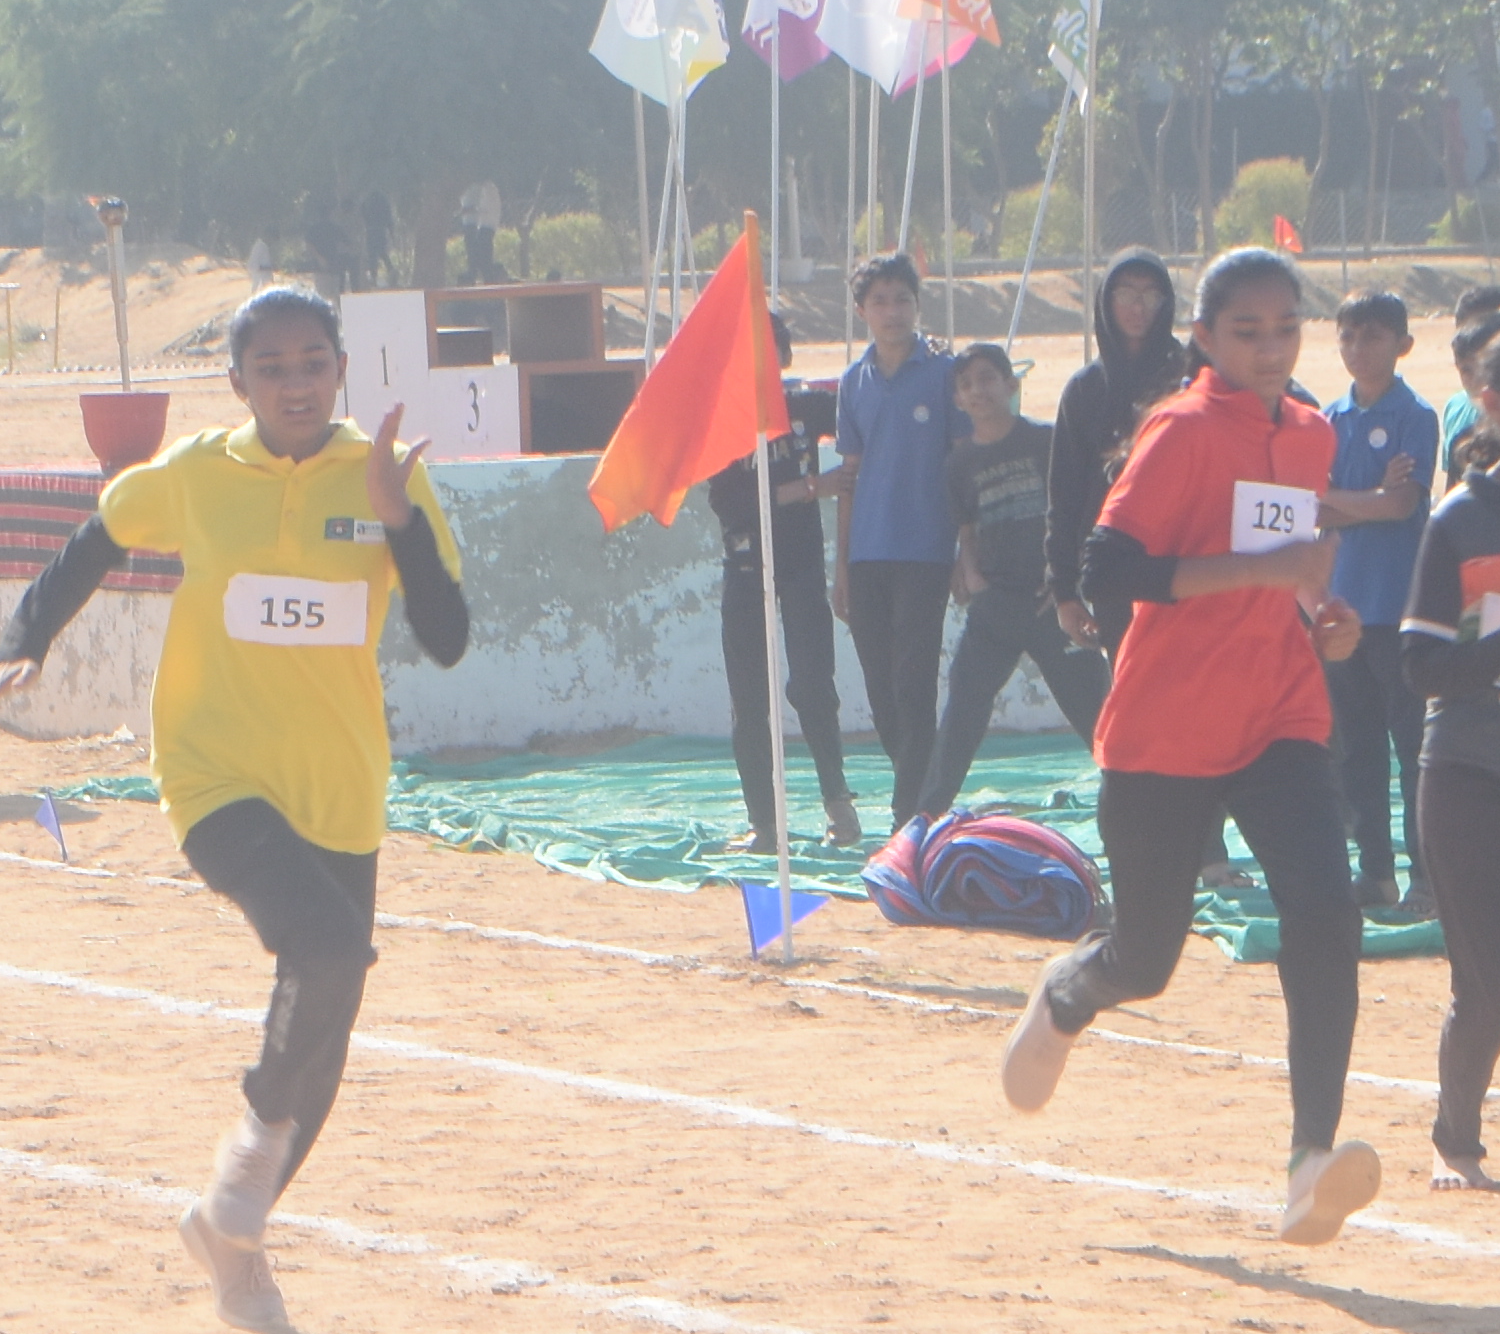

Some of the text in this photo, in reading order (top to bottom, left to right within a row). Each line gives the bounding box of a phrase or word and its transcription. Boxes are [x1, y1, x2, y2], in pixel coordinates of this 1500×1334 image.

[381, 344, 390, 387] 1
[467, 381, 480, 432] 3
[1252, 500, 1295, 534] 129
[260, 597, 325, 629] 155
